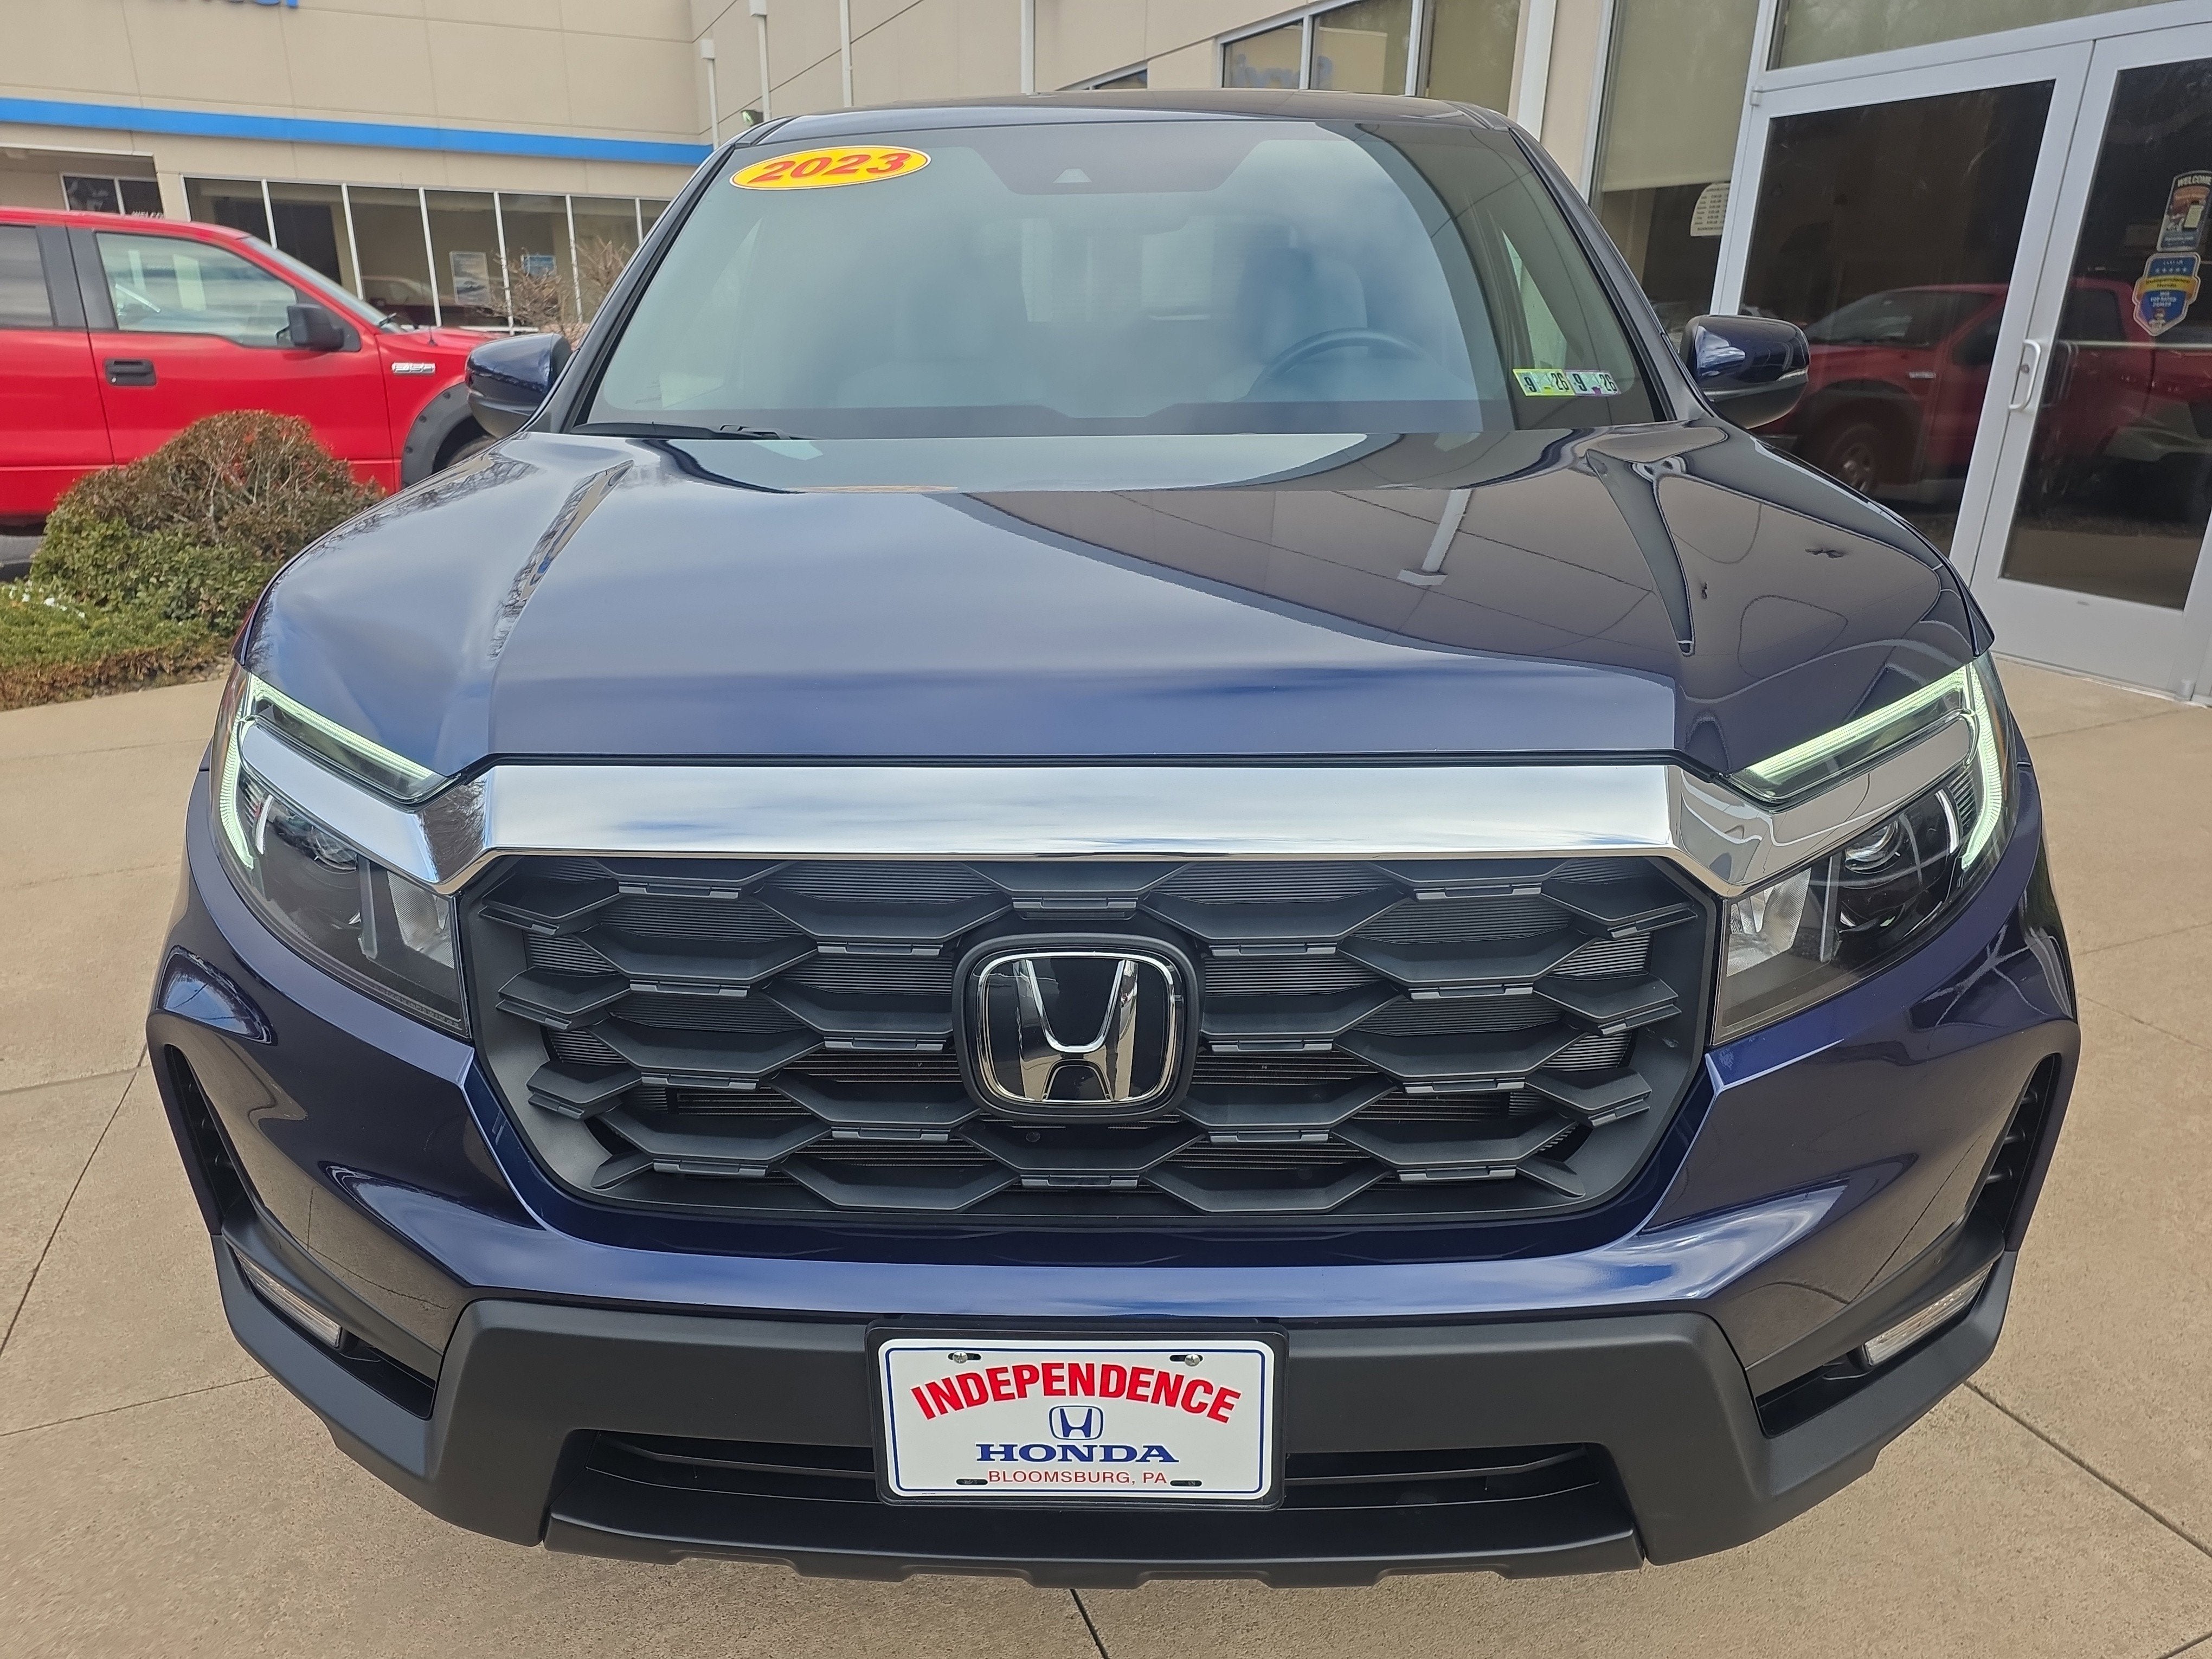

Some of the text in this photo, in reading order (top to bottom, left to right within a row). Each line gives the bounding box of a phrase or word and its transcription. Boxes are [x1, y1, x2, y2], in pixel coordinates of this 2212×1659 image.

[747, 153, 912, 184] 2023
[910, 1362, 1242, 1424] INDEPENDENCE
[976, 1444, 1180, 1463] HONDA
[988, 1470, 1167, 1486] BLOOMSBURG, PA
